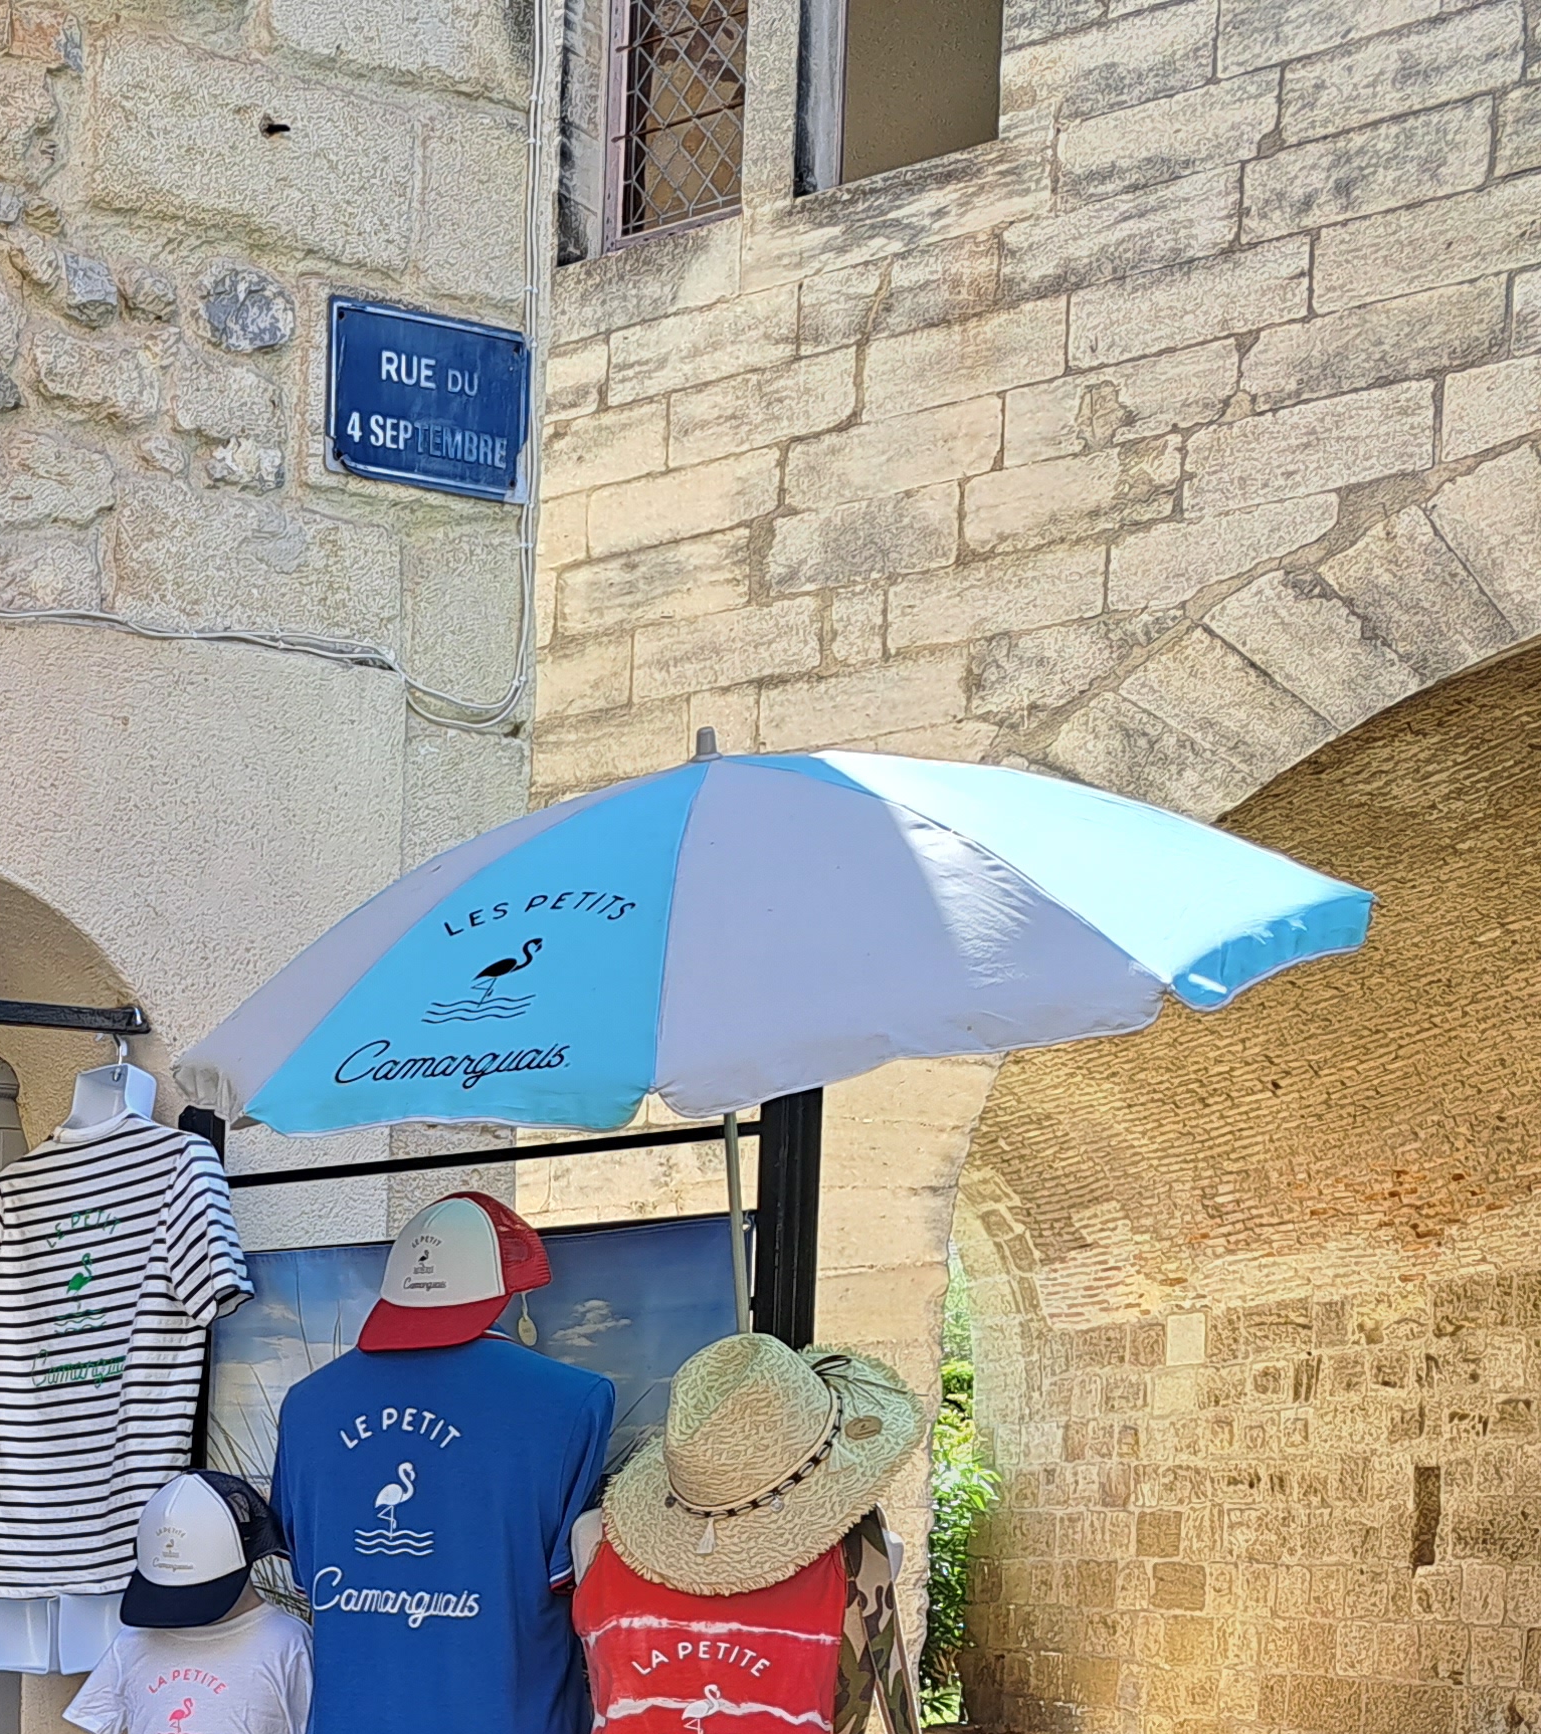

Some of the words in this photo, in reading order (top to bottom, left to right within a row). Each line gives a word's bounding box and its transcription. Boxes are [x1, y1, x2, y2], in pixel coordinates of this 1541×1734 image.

[381, 350, 437, 390] RUE
[447, 369, 479, 398] DU
[346, 411, 363, 444] 4
[369, 414, 508, 470] SEPTEMBRE
[443, 902, 510, 938] LES
[524, 891, 637, 922] PETITS
[339, 1415, 373, 1449] LE
[382, 1407, 461, 1449] PETIT
[312, 1566, 481, 1629] Camarguais
[148, 1675, 168, 1694] LA
[172, 1668, 228, 1694] PETITE
[631, 1649, 670, 1675] LA
[677, 1641, 771, 1677] PETITE
